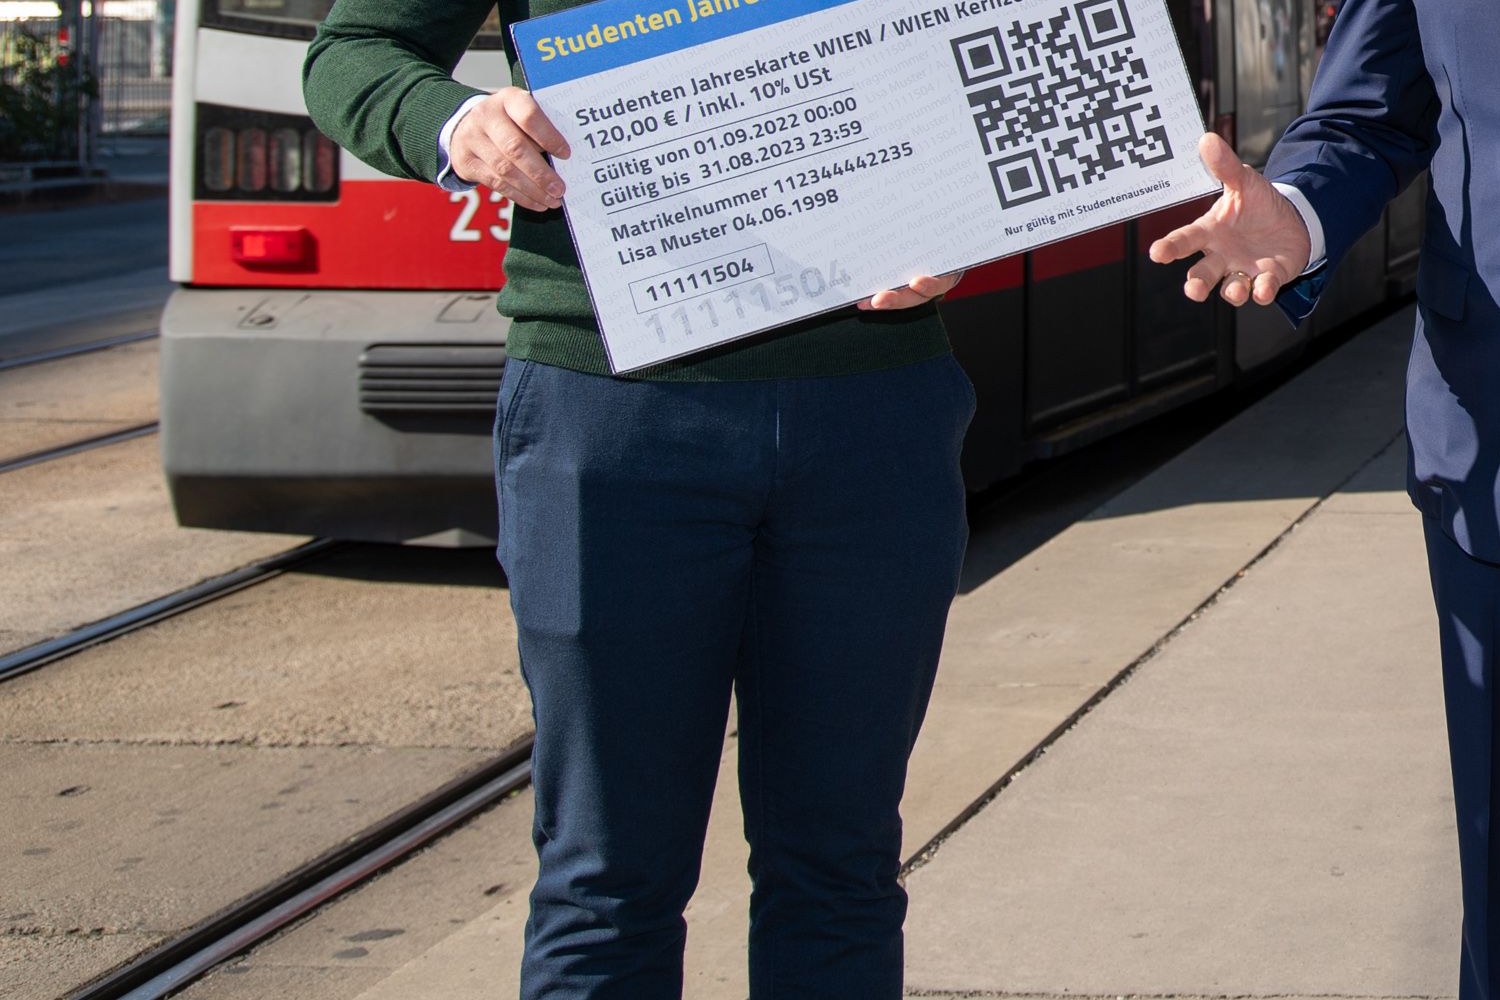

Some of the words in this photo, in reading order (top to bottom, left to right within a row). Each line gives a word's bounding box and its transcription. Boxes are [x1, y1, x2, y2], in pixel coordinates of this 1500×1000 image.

[535, 7, 682, 62] Studenten
[574, 84, 687, 128] Studenten
[689, 49, 812, 97] Jahreskarte
[812, 27, 874, 59] WIEN
[879, 22, 886, 43] /
[890, 5, 952, 37] WIEN
[583, 115, 659, 150] 120,00
[662, 109, 679, 128] €
[684, 103, 692, 124] /
[697, 91, 746, 118] inkl.
[749, 77, 792, 103] 10%
[792, 66, 834, 91] USt
[592, 157, 654, 185] Gültig
[654, 147, 691, 167] von
[692, 112, 801, 156] 01.09.2022
[803, 96, 858, 124] 00:00
[600, 180, 661, 208] Gültig
[660, 170, 692, 191] bis
[698, 135, 806, 180] 31.08.2023
[808, 119, 863, 148] 23:59
[610, 185, 769, 243] Matrikelnummer
[772, 140, 914, 194] 112344442235
[617, 244, 658, 266] Lisa
[659, 222, 728, 254] Muster
[731, 187, 840, 232] 04.06.1998
[1003, 224, 1024, 237] Nur
[1025, 214, 1058, 233] gültig
[1056, 208, 1076, 221] mit
[645, 257, 755, 302] 11111504
